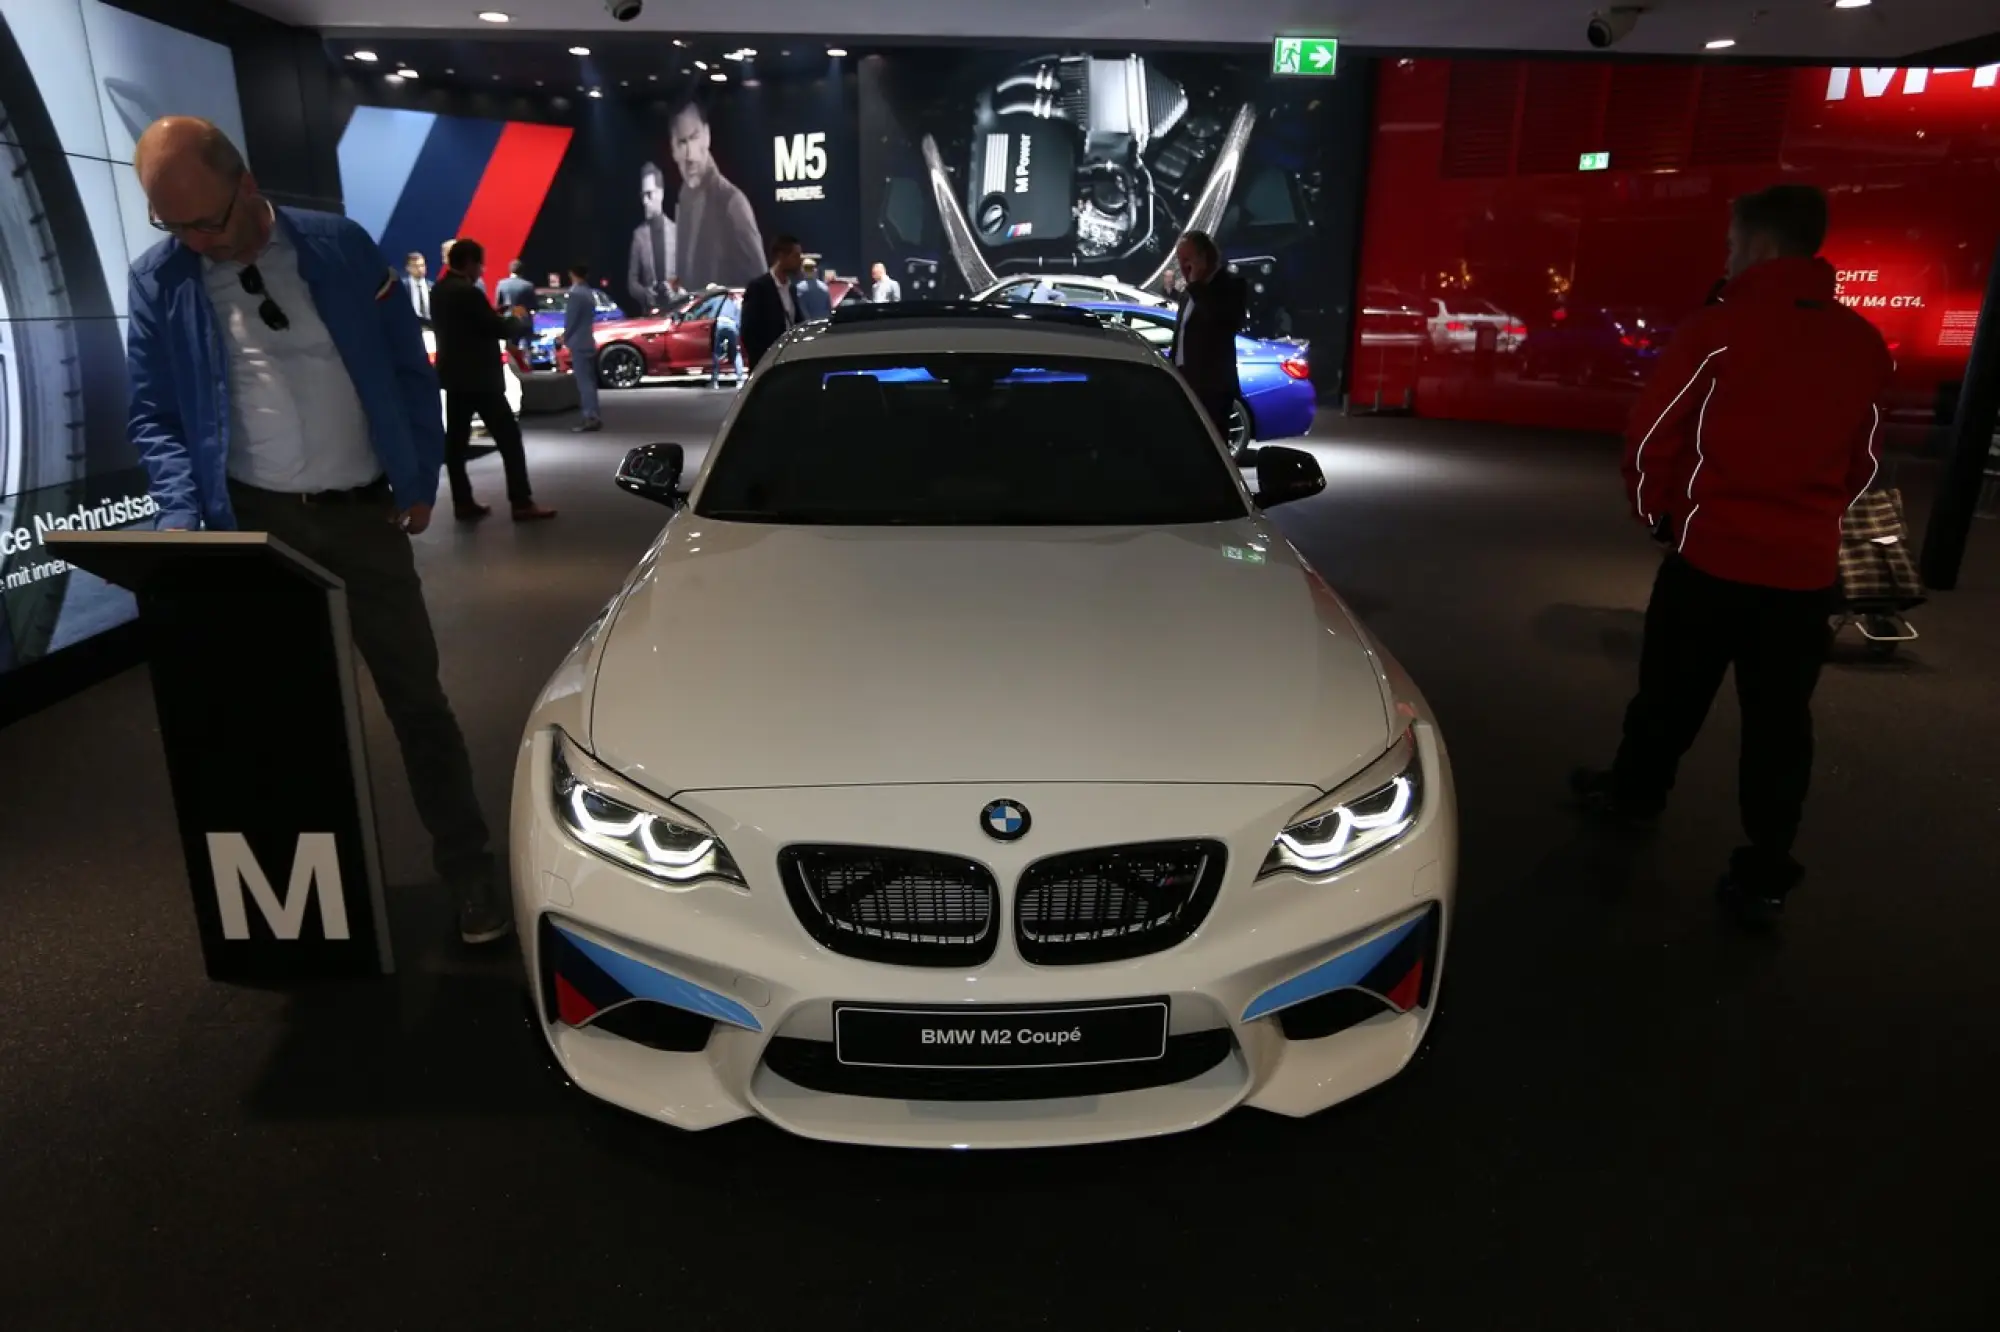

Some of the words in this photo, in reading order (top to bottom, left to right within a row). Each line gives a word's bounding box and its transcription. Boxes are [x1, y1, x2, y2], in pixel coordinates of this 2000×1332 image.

[774, 132, 827, 181] M5
[1014, 177, 1029, 193] M
[1863, 296, 1887, 308] M4
[1890, 296, 1926, 308] GT4.
[206, 832, 350, 940] M
[921, 1028, 976, 1044] BMW
[980, 1029, 1012, 1044] M2
[1016, 1026, 1082, 1046] Coupé
